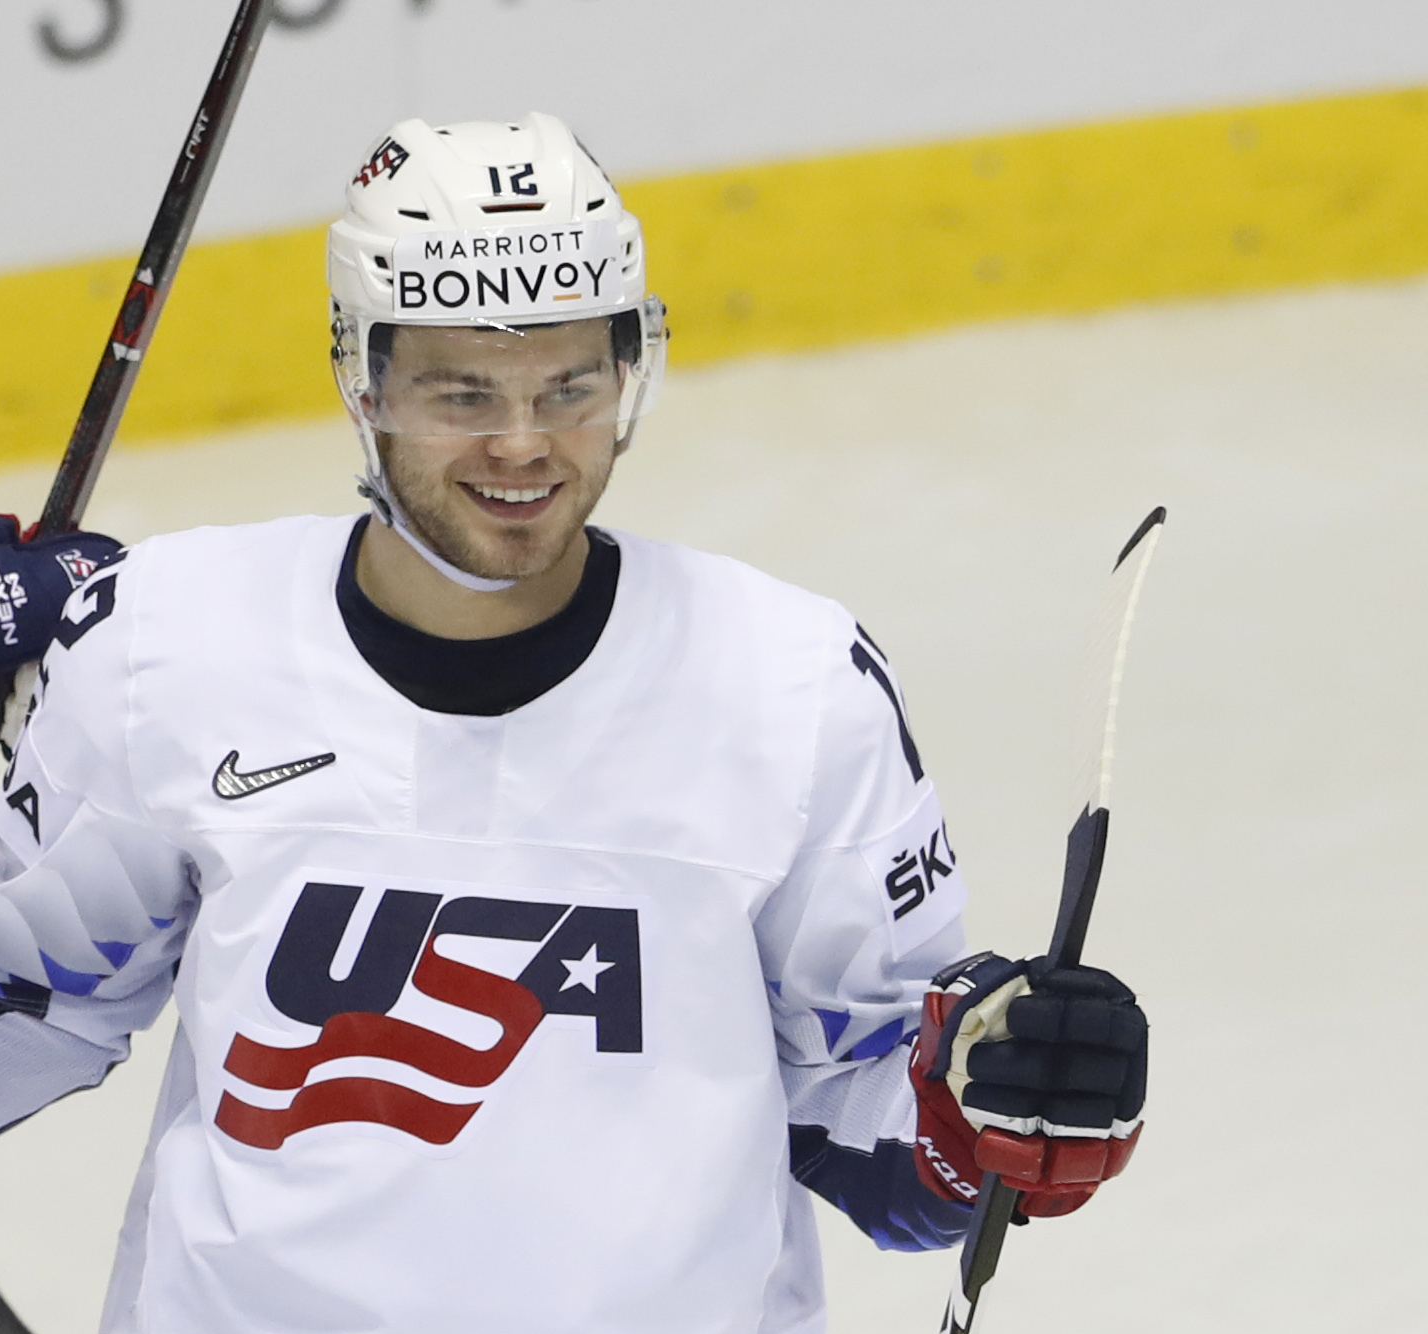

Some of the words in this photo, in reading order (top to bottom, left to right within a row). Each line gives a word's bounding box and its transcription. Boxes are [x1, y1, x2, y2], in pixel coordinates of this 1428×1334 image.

[488, 163, 538, 197] 12
[424, 231, 584, 260] MARRIOTT
[399, 257, 610, 309] BONVOY
[255, 882, 644, 1070] USA
[917, 1136, 979, 1199] CCM
